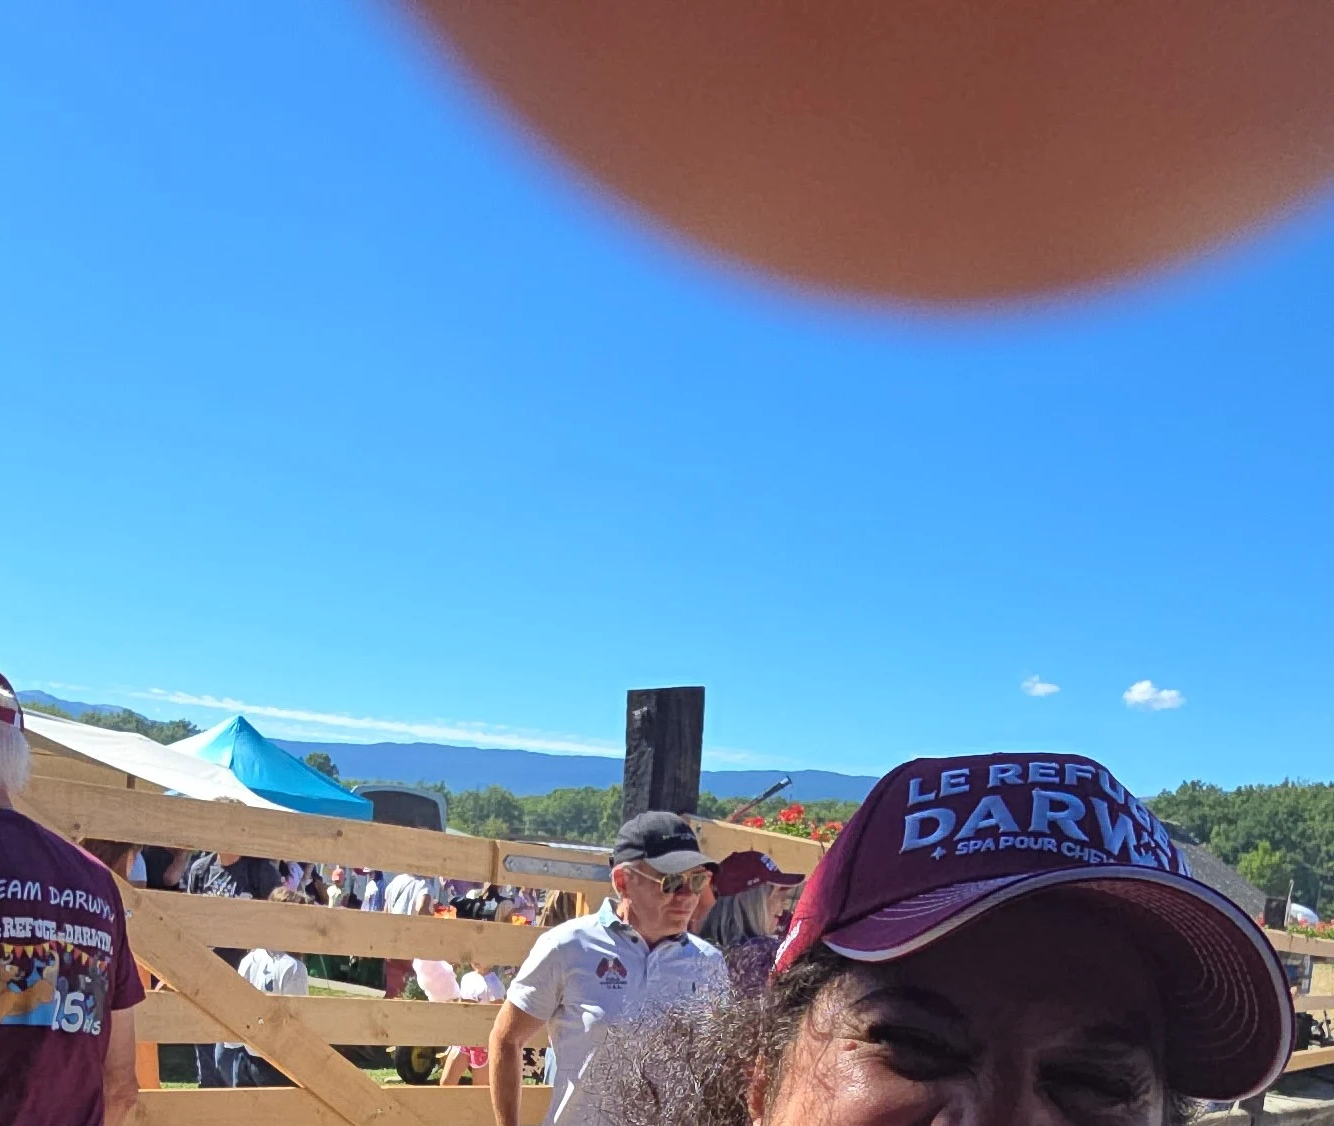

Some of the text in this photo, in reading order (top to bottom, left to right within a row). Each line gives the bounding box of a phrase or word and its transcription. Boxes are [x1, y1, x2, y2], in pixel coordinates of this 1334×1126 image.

[907, 768, 970, 807] LE
[899, 787, 1170, 870] DARW
[955, 837, 995, 856] SPA
[999, 836, 1058, 852] POUR
[2, 917, 57, 939] REFUGE
